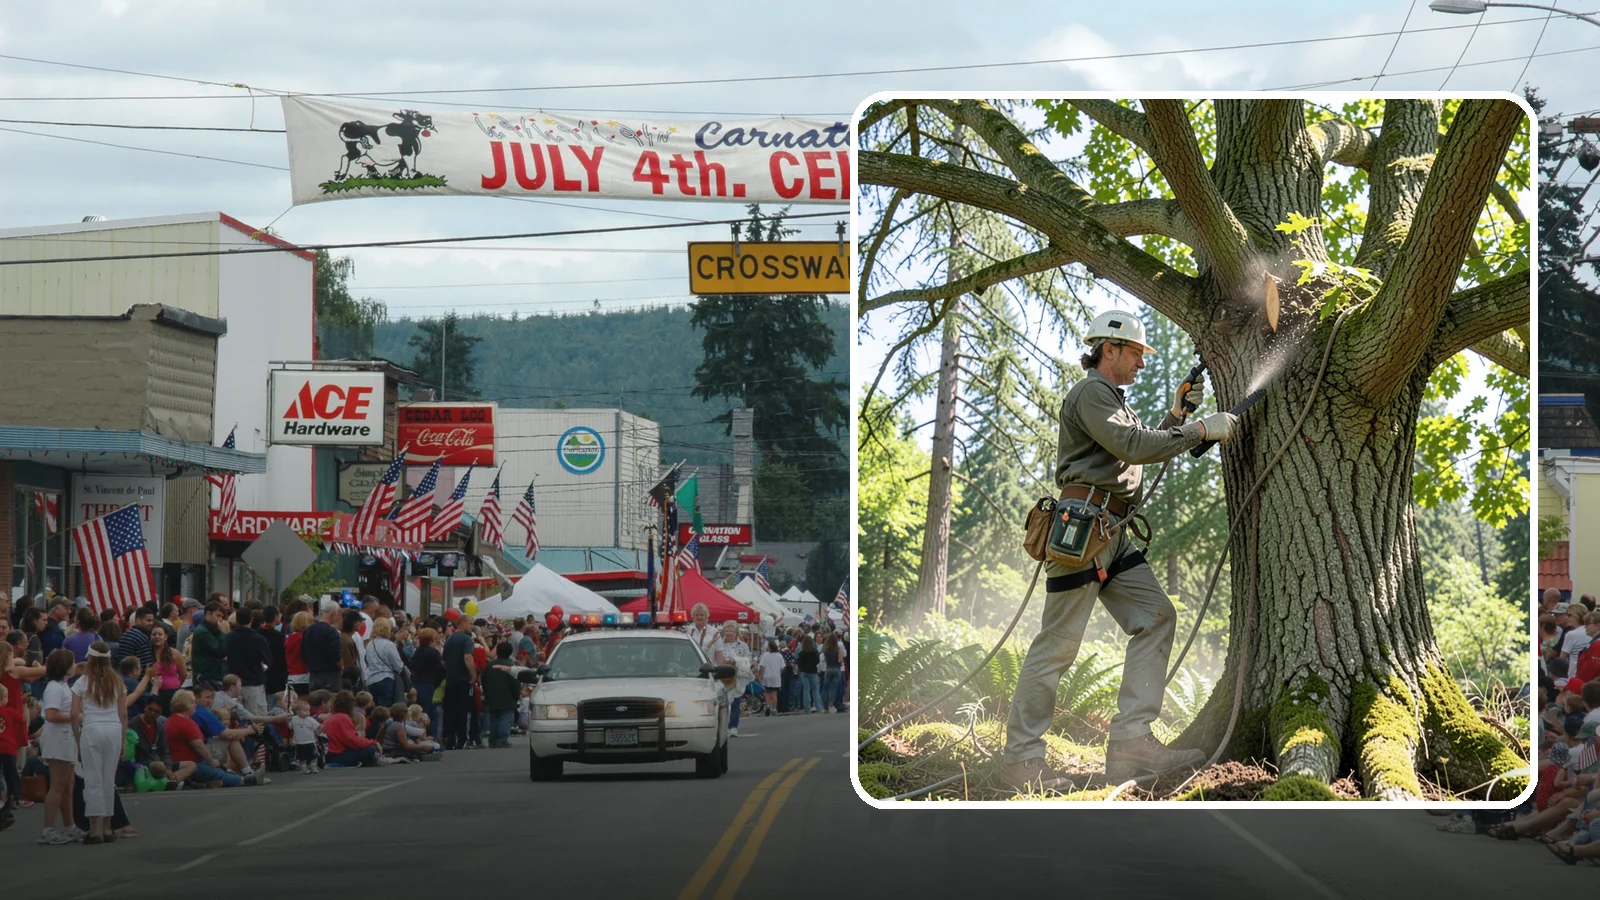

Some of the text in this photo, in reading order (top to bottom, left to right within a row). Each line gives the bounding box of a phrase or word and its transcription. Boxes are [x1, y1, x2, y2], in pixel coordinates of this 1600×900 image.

[695, 121, 850, 150] Carnat
[481, 141, 604, 192] JULY
[632, 150, 746, 197] 4th.
[697, 254, 850, 279] CROSSWA
[283, 380, 373, 420] ACE
[406, 409, 452, 422] CEDAR
[284, 421, 370, 436] Hardware
[416, 428, 476, 447] Coca-Cola
[96, 486, 124, 494] Vincent
[126, 486, 136, 494] de
[137, 487, 155, 495] Paul
[688, 526, 741, 535] CRNATION
[699, 535, 730, 543] GLASS
